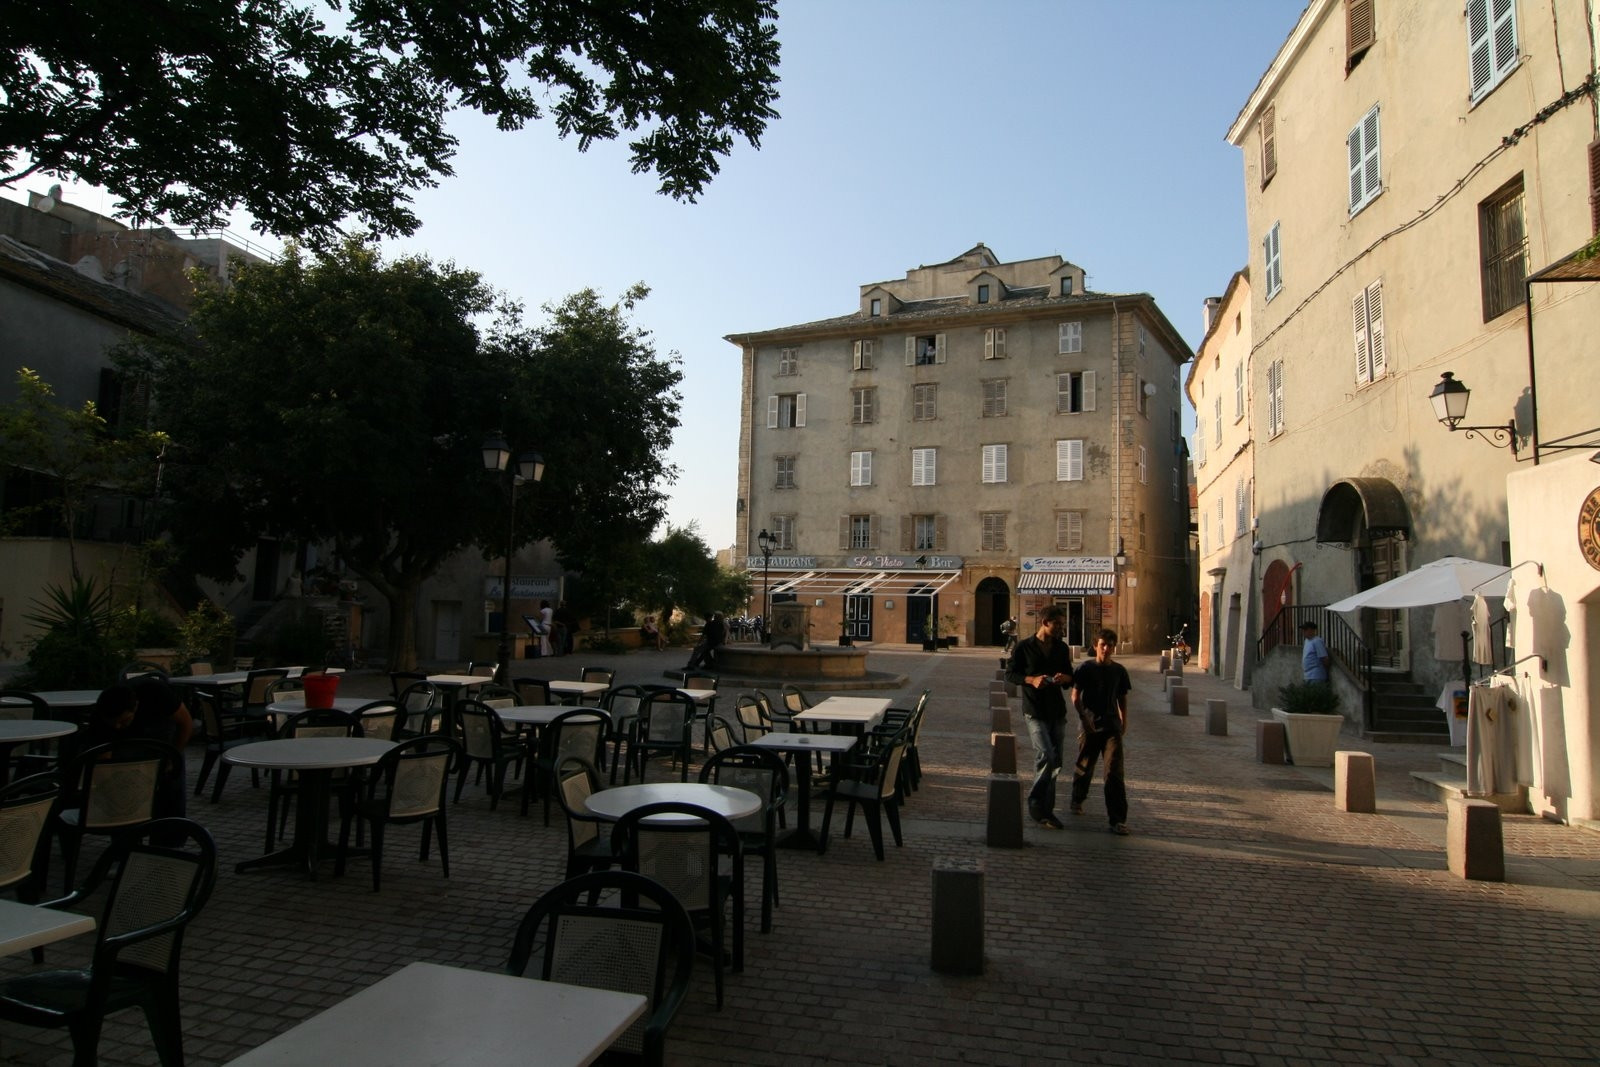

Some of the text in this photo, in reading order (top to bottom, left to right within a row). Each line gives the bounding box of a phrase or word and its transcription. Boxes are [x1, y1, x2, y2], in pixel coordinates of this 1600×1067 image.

[1582, 498, 1598, 524] THE
[853, 556, 873, 567] La
[931, 556, 953, 567] Bar
